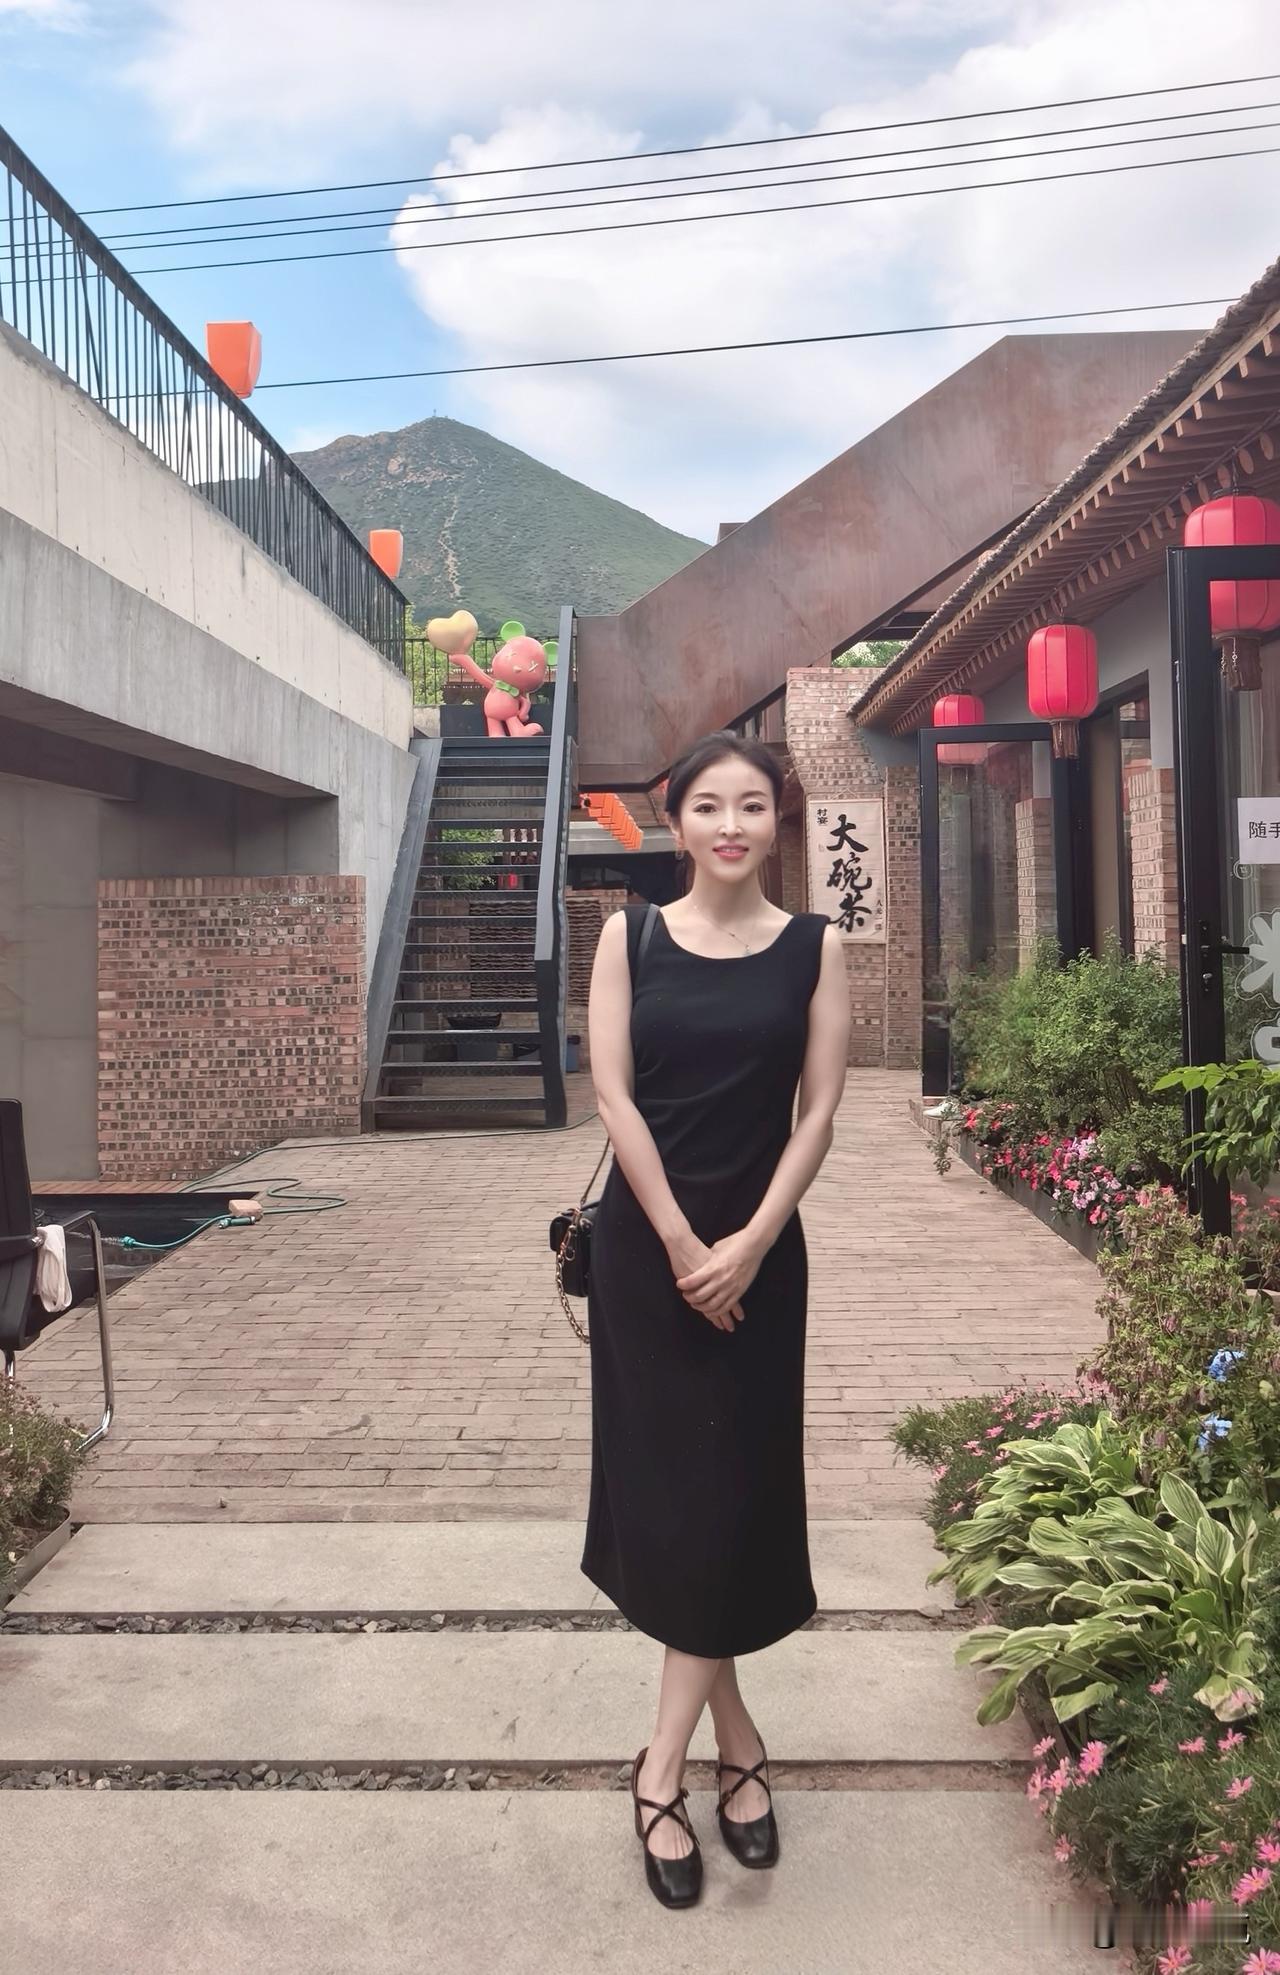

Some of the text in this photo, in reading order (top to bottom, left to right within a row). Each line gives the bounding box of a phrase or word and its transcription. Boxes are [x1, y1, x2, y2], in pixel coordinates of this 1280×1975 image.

[1249, 821, 1280, 838] 随手
[827, 814, 873, 933] 大碗茶
